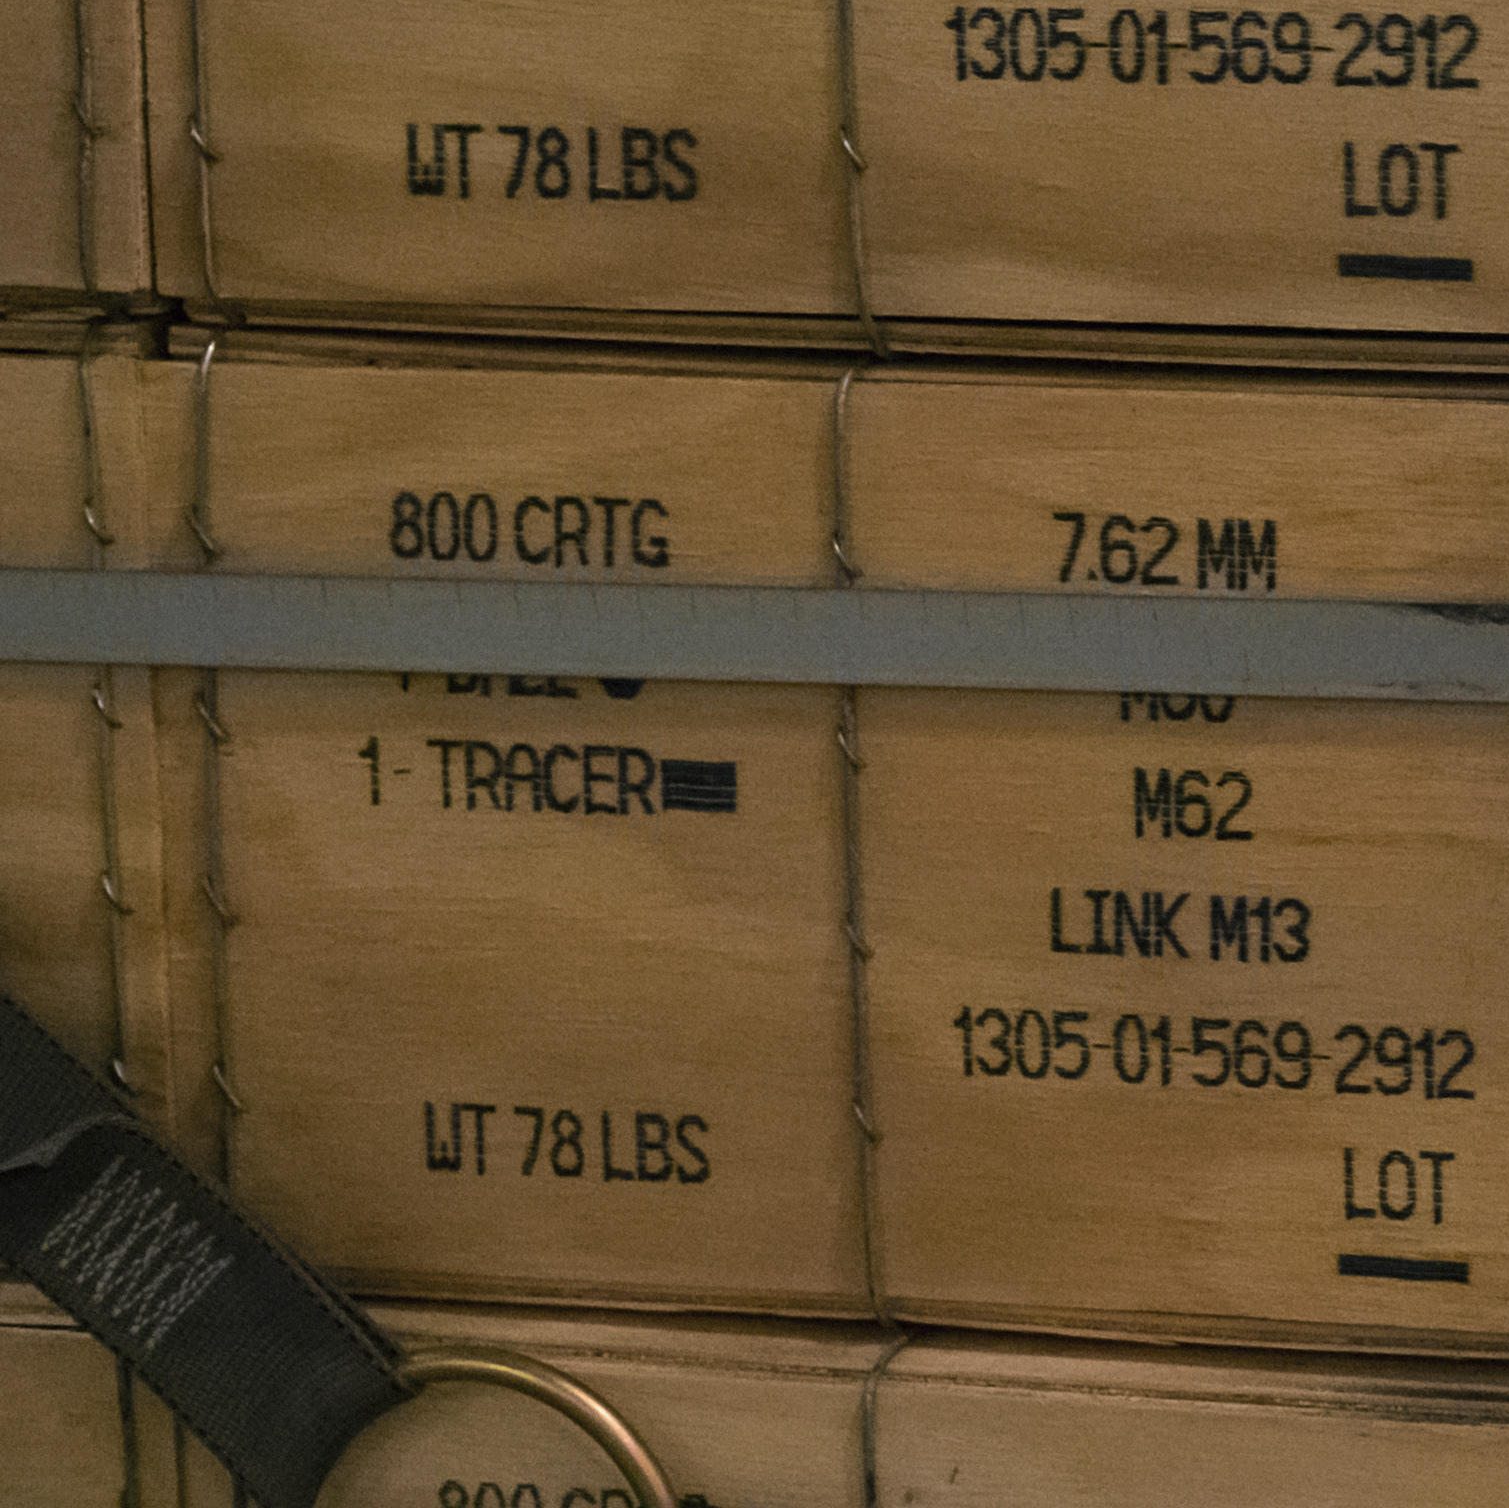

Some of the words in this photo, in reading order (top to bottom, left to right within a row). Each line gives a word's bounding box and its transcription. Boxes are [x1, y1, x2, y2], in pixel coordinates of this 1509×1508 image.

[945, 6, 1479, 90] 1305-01-569-2912
[407, 123, 483, 200] WT
[498, 125, 572, 200] 78
[588, 127, 699, 203] LBS
[1343, 142, 1460, 220] LOT
[389, 492, 498, 563] 800
[513, 495, 670, 569] CRTG
[1052, 511, 1180, 587] 7.62
[1197, 519, 1277, 591] MM
[426, 738, 657, 816] TRACER
[1134, 768, 1254, 841] M62
[1050, 888, 1190, 959] LINK
[1209, 895, 1311, 963] M13
[953, 1006, 1476, 1100] 1305-01-569-2912
[424, 1102, 497, 1176] WT
[513, 1105, 585, 1178] 78
[601, 1111, 711, 1185] LBS
[1343, 1147, 1456, 1225] LOT
